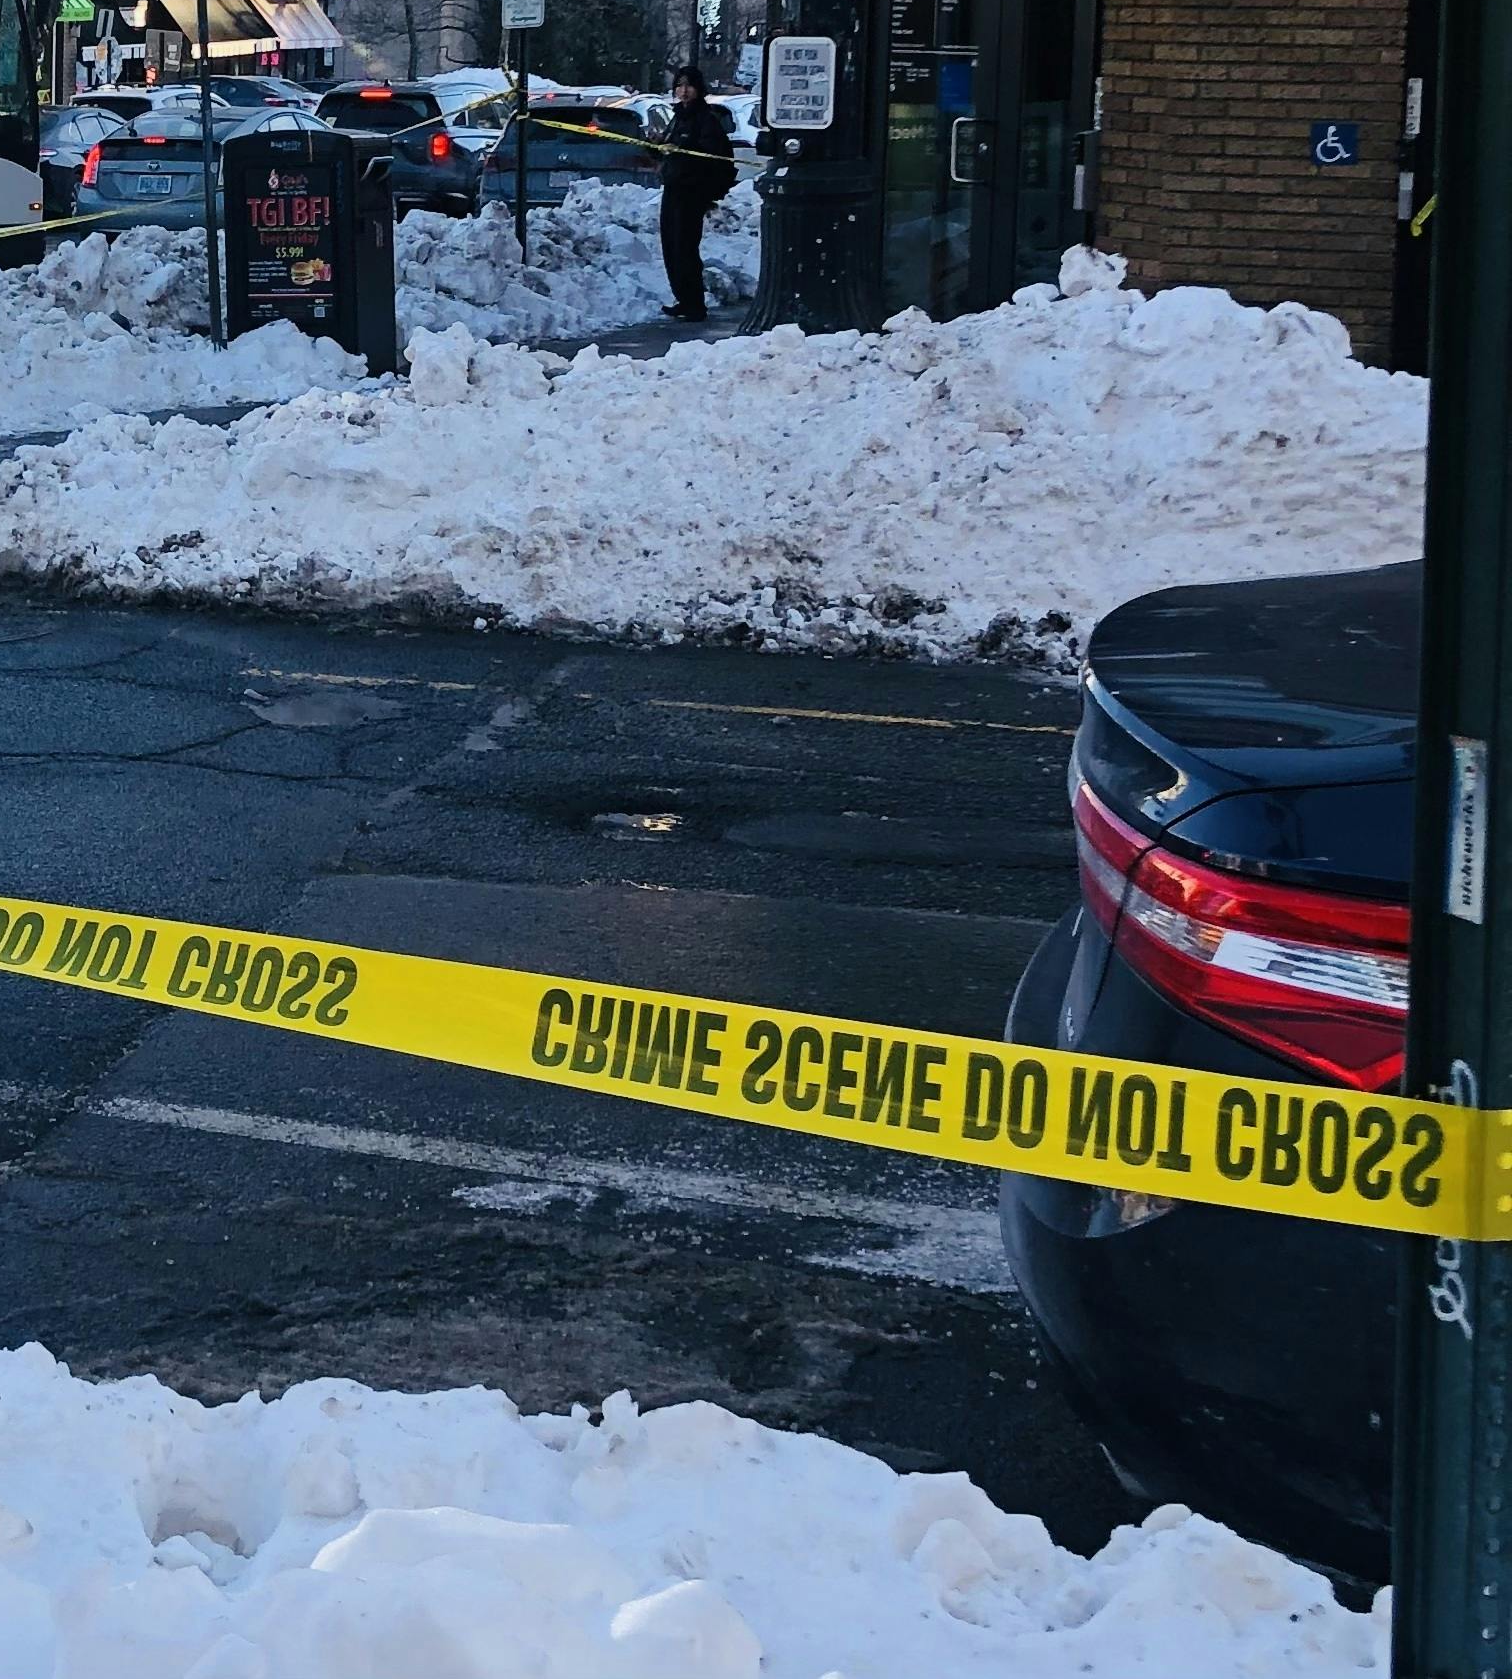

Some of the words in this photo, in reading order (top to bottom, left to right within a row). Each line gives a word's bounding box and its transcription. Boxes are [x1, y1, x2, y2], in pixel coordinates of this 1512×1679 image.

[247, 196, 285, 226] TGI
[292, 196, 330, 226] BF!
[260, 232, 287, 246] Every
[288, 232, 319, 247] Friday
[275, 246, 304, 258] $5.99!
